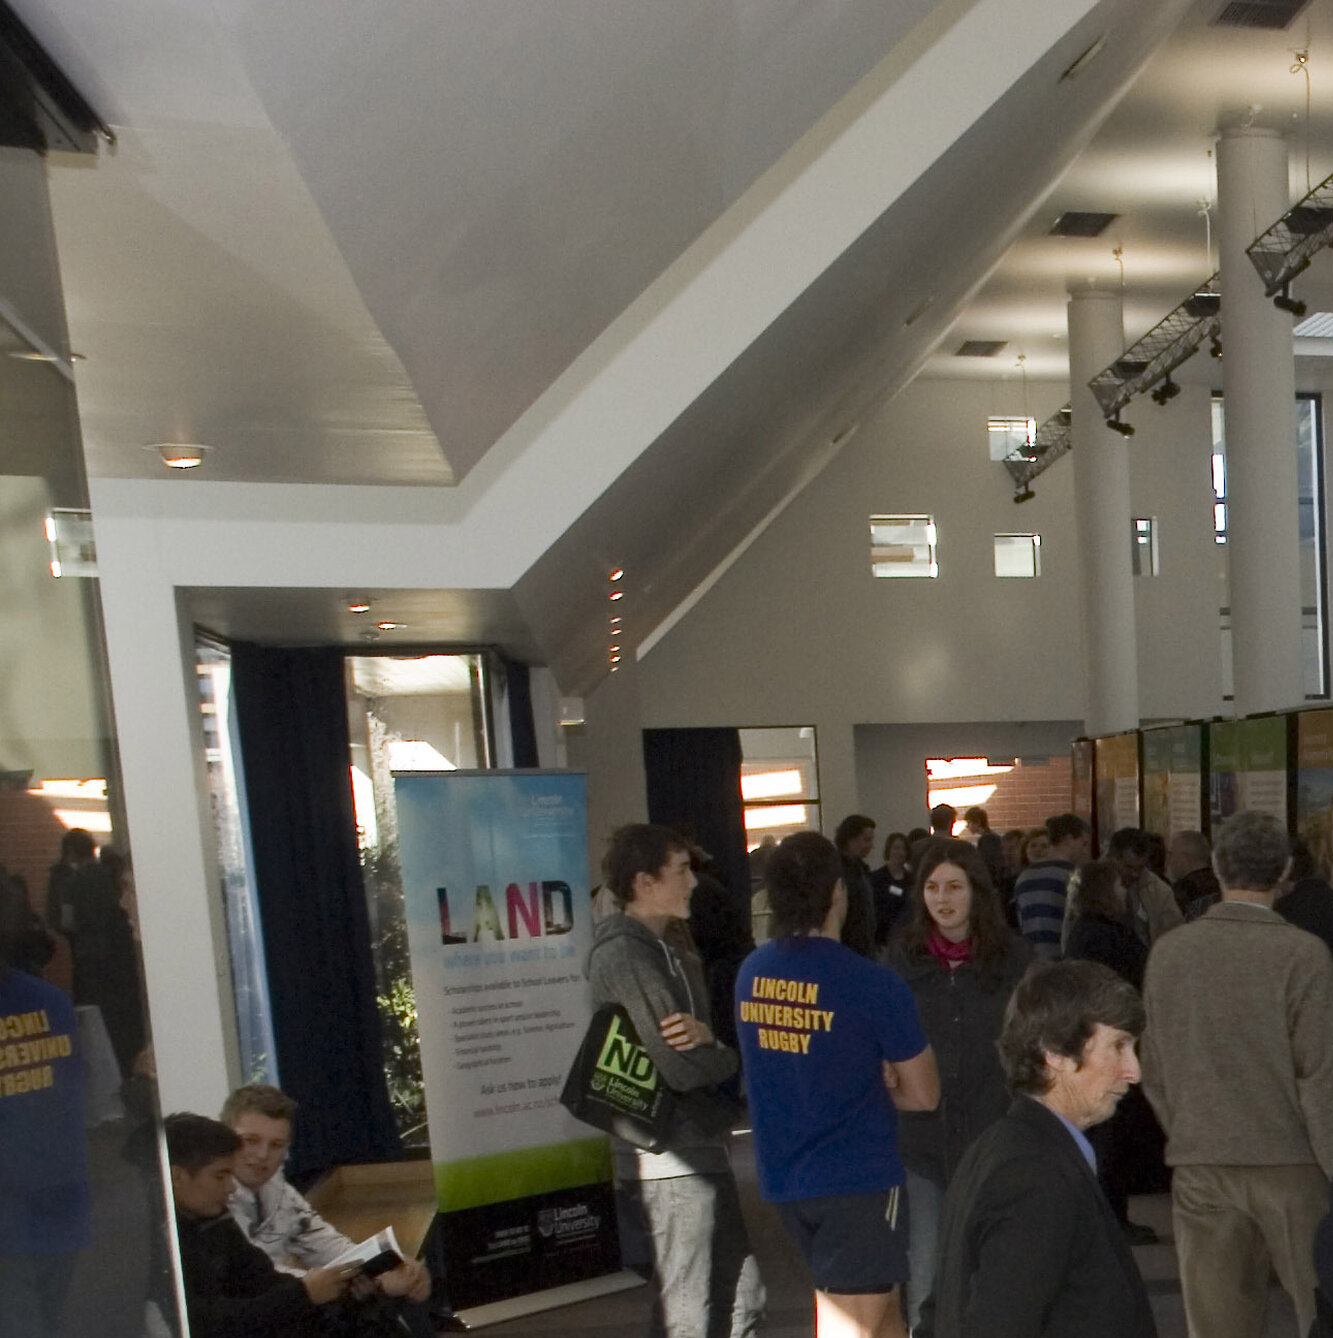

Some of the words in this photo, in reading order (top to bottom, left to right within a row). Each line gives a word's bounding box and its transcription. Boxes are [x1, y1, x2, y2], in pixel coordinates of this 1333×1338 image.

[436, 880, 574, 945] LAND
[752, 976, 819, 1005] LINCOLN
[740, 1001, 835, 1032] UNIVERSITY
[758, 1028, 811, 1055] RUGBY
